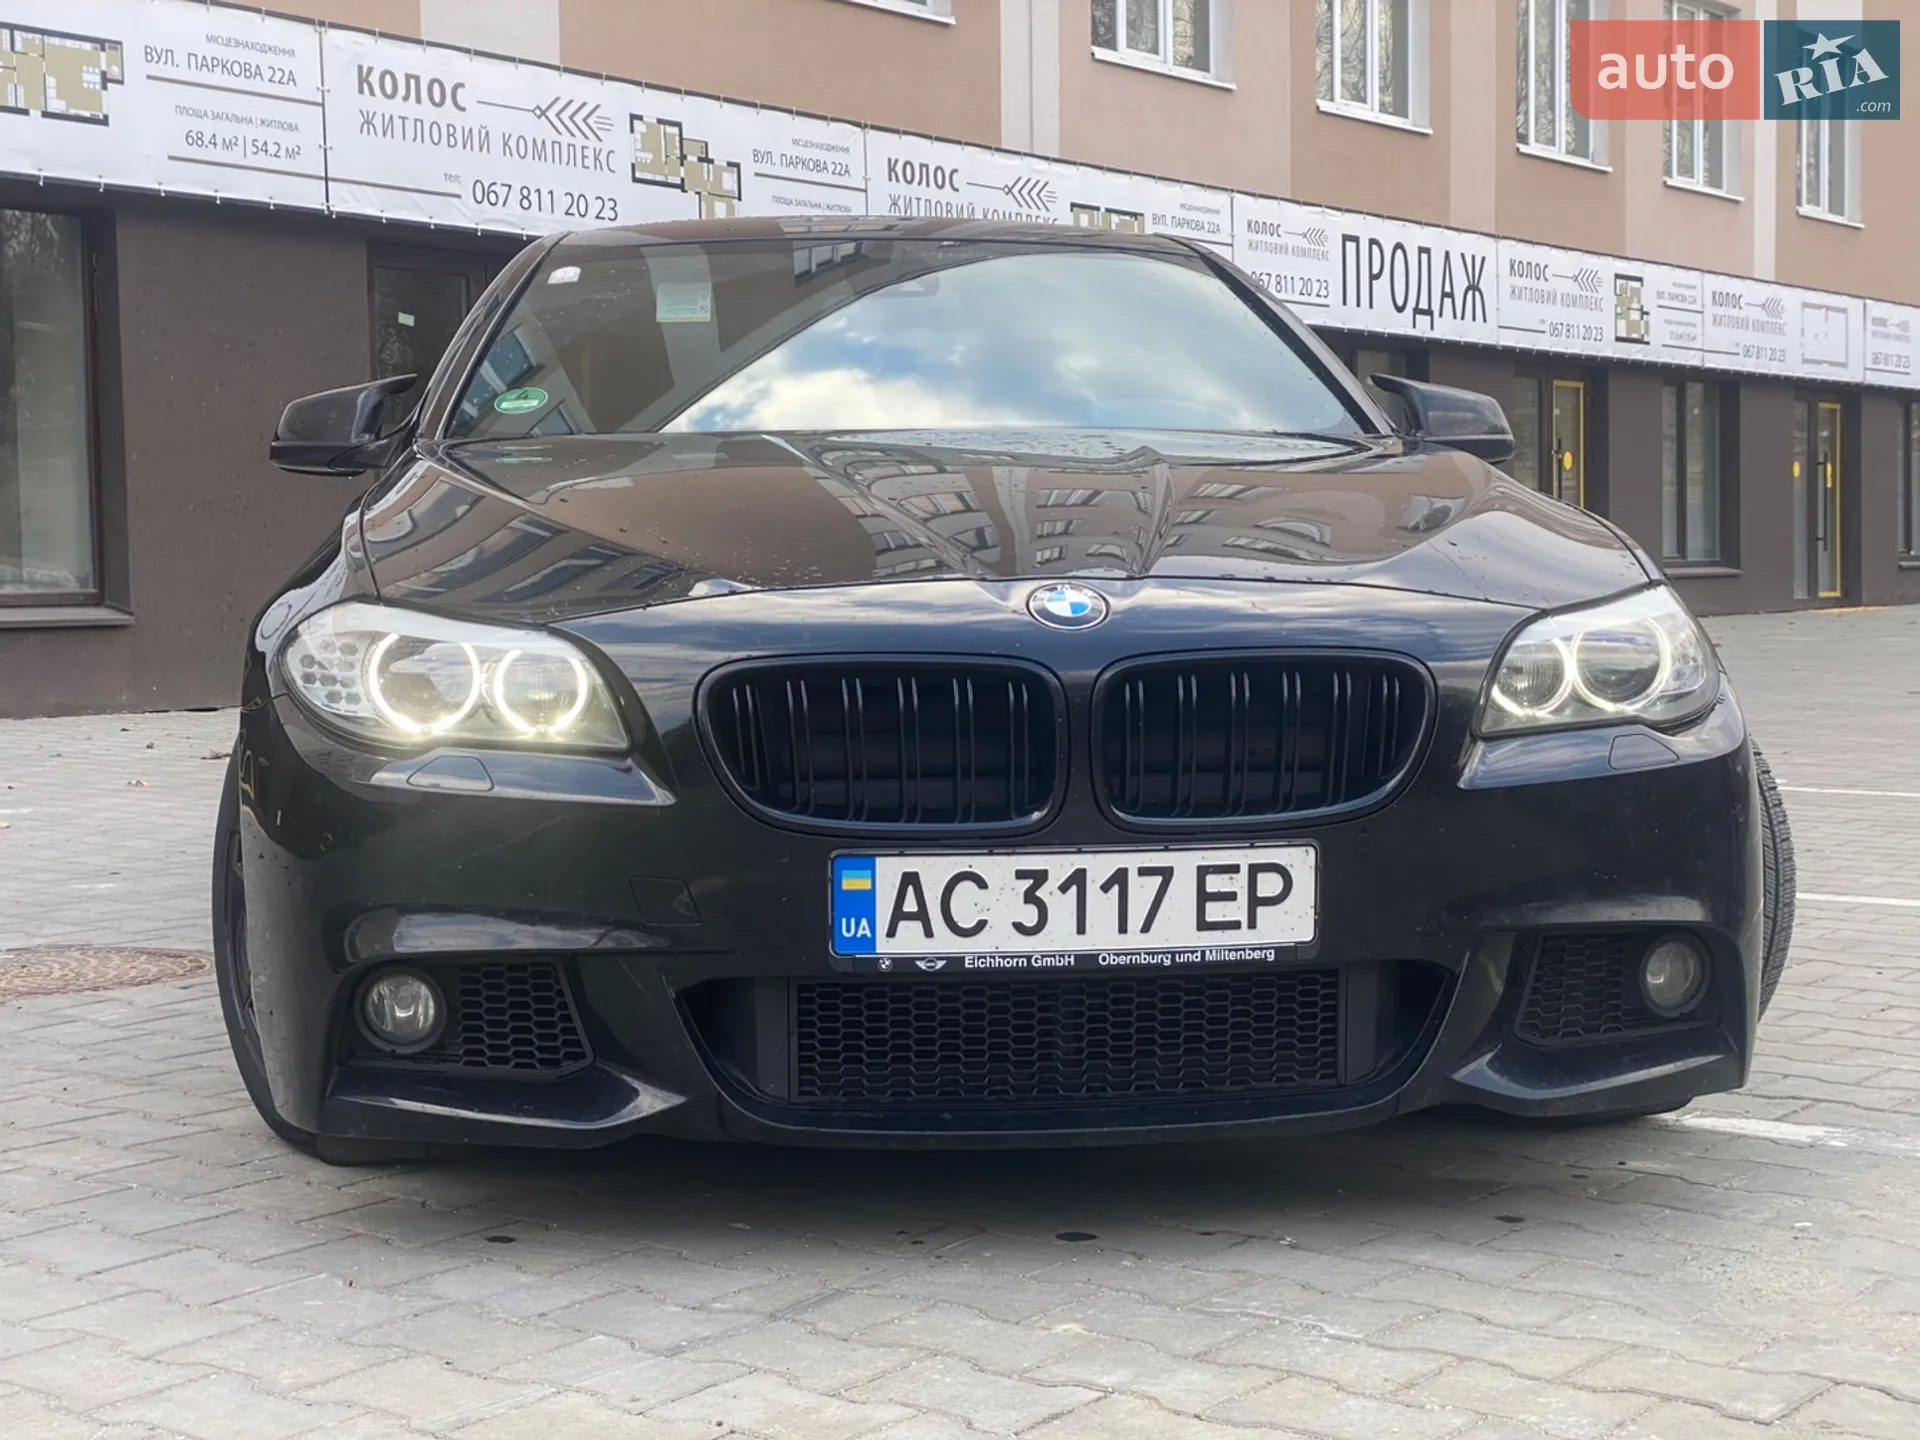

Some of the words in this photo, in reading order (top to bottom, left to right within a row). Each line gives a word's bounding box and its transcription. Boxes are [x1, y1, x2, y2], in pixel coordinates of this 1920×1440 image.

[205, 33, 296, 58] МІСЦЕЗНАХОДЖЕННЯ
[144, 45, 179, 68] ВУЛ.
[187, 52, 264, 82] ПАРКОВА
[267, 66, 297, 87] 22А
[357, 63, 467, 113] КОЛОС
[174, 104, 209, 120] ПЛОЩА
[210, 110, 254, 126] ЗАГАЛЬНА
[258, 118, 300, 132] ЖИТЛОВА
[185, 130, 218, 149] 68.4
[251, 138, 281, 158] 54.2
[359, 108, 491, 154] ЖИТЛОВИЙ
[502, 131, 617, 174] КОМПЛЕКС
[752, 147, 776, 166] ВУЛ.
[780, 153, 829, 175] ПАРКОВА
[831, 161, 851, 178] 22А
[887, 157, 960, 192] КОЛОС
[472, 179, 512, 208] 067
[519, 185, 555, 214] 811
[564, 191, 589, 218] 20
[594, 195, 619, 222] 23
[1246, 218, 1282, 238] КОЛОС
[1248, 238, 1289, 256] ЖИТЛОВИЙ
[1291, 244, 1330, 262] КОМПЛЕКС
[1341, 233, 1487, 331] ПРОДАЖ
[1509, 258, 1549, 283] КОЛОС
[1274, 273, 1295, 295] 811
[1298, 277, 1313, 297] 20
[1315, 278, 1330, 299] 23
[1509, 284, 1558, 307] ЖИТЛОВИЙ
[1560, 292, 1604, 312] КОМПЛЕКС
[1712, 289, 1743, 310] КОЛОС
[1549, 321, 1564, 338] 067
[1565, 323, 1581, 340] 811
[1582, 324, 1593, 341] 20
[1593, 326, 1604, 343] 23
[885, 870, 990, 939] AC
[1010, 866, 1175, 936] 3117
[1195, 861, 1294, 932] EP
[841, 918, 872, 938] UA
[964, 955, 1027, 969] Eichhorn
[1031, 954, 1075, 968] GmbH
[1098, 952, 1171, 966] Obernburg
[1175, 951, 1200, 963] und
[1205, 948, 1275, 961] Miltenberg
